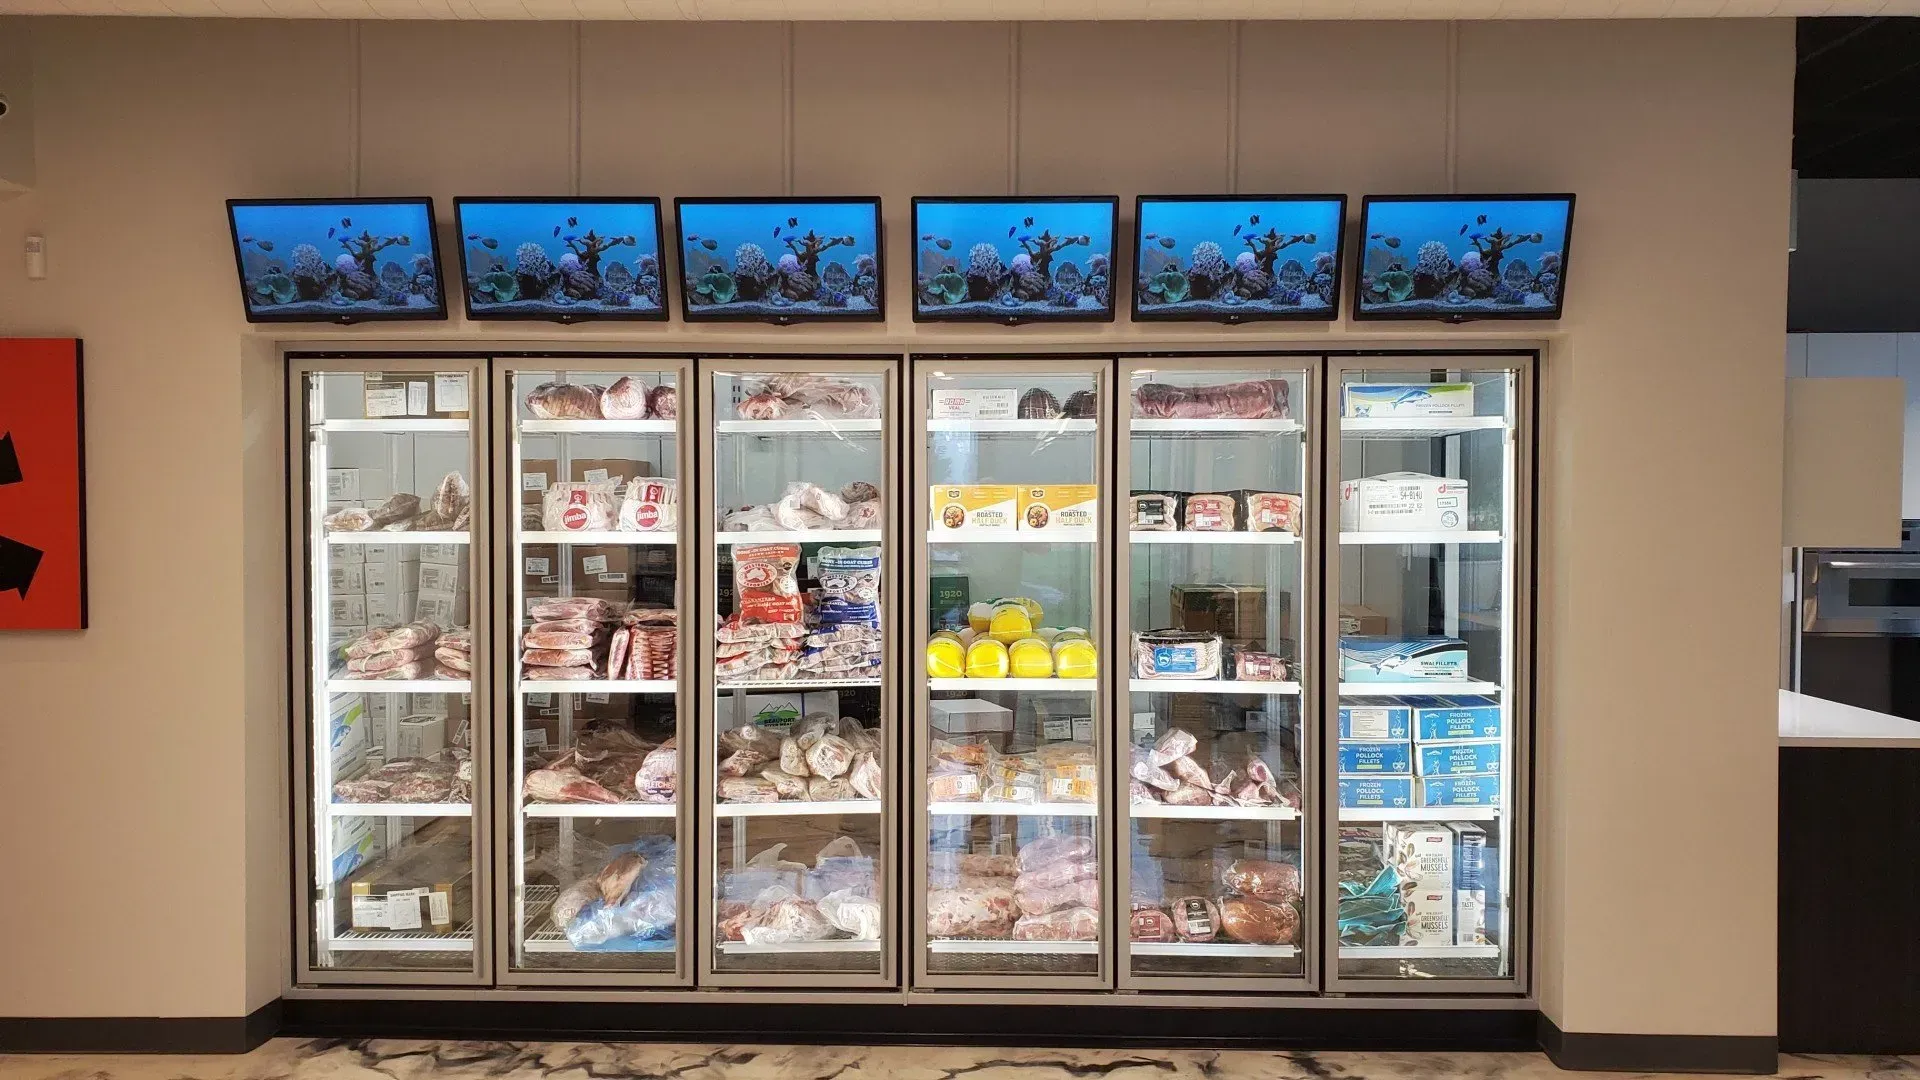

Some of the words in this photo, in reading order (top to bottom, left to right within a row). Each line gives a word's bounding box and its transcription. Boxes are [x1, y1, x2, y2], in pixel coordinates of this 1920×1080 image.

[564, 511, 588, 524] jimba
[637, 511, 658, 521] jimba
[718, 555, 733, 564] 192
[719, 588, 733, 597] 192
[940, 590, 962, 599] 1920
[1420, 863, 1448, 872] MUSSELS
[1420, 922, 1448, 930] MUSSELS
